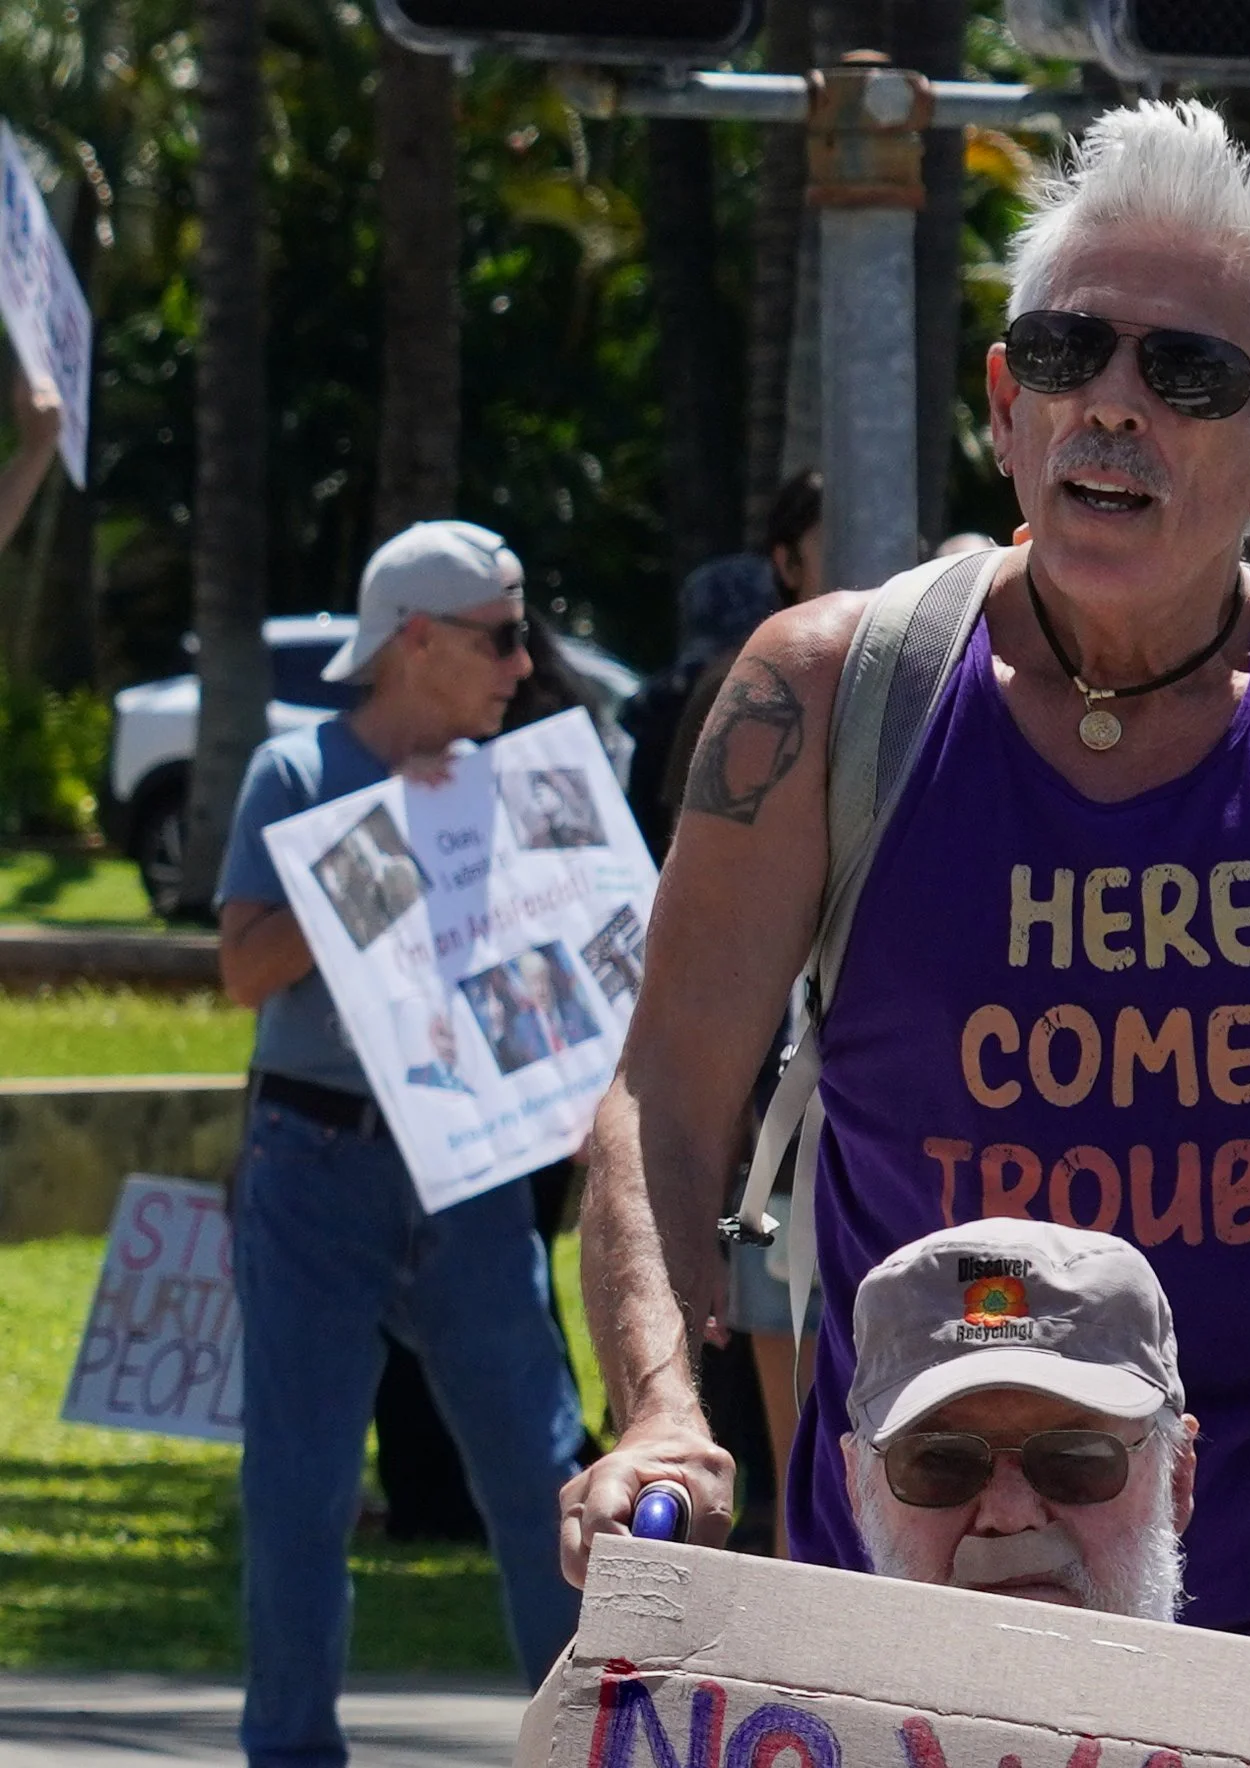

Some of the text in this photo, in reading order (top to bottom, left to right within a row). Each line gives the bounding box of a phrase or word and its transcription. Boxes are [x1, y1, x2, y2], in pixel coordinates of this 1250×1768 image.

[119, 1191, 234, 1278] ST
[958, 1256, 1032, 1282] Discover
[69, 1322, 244, 1426] PEOPL
